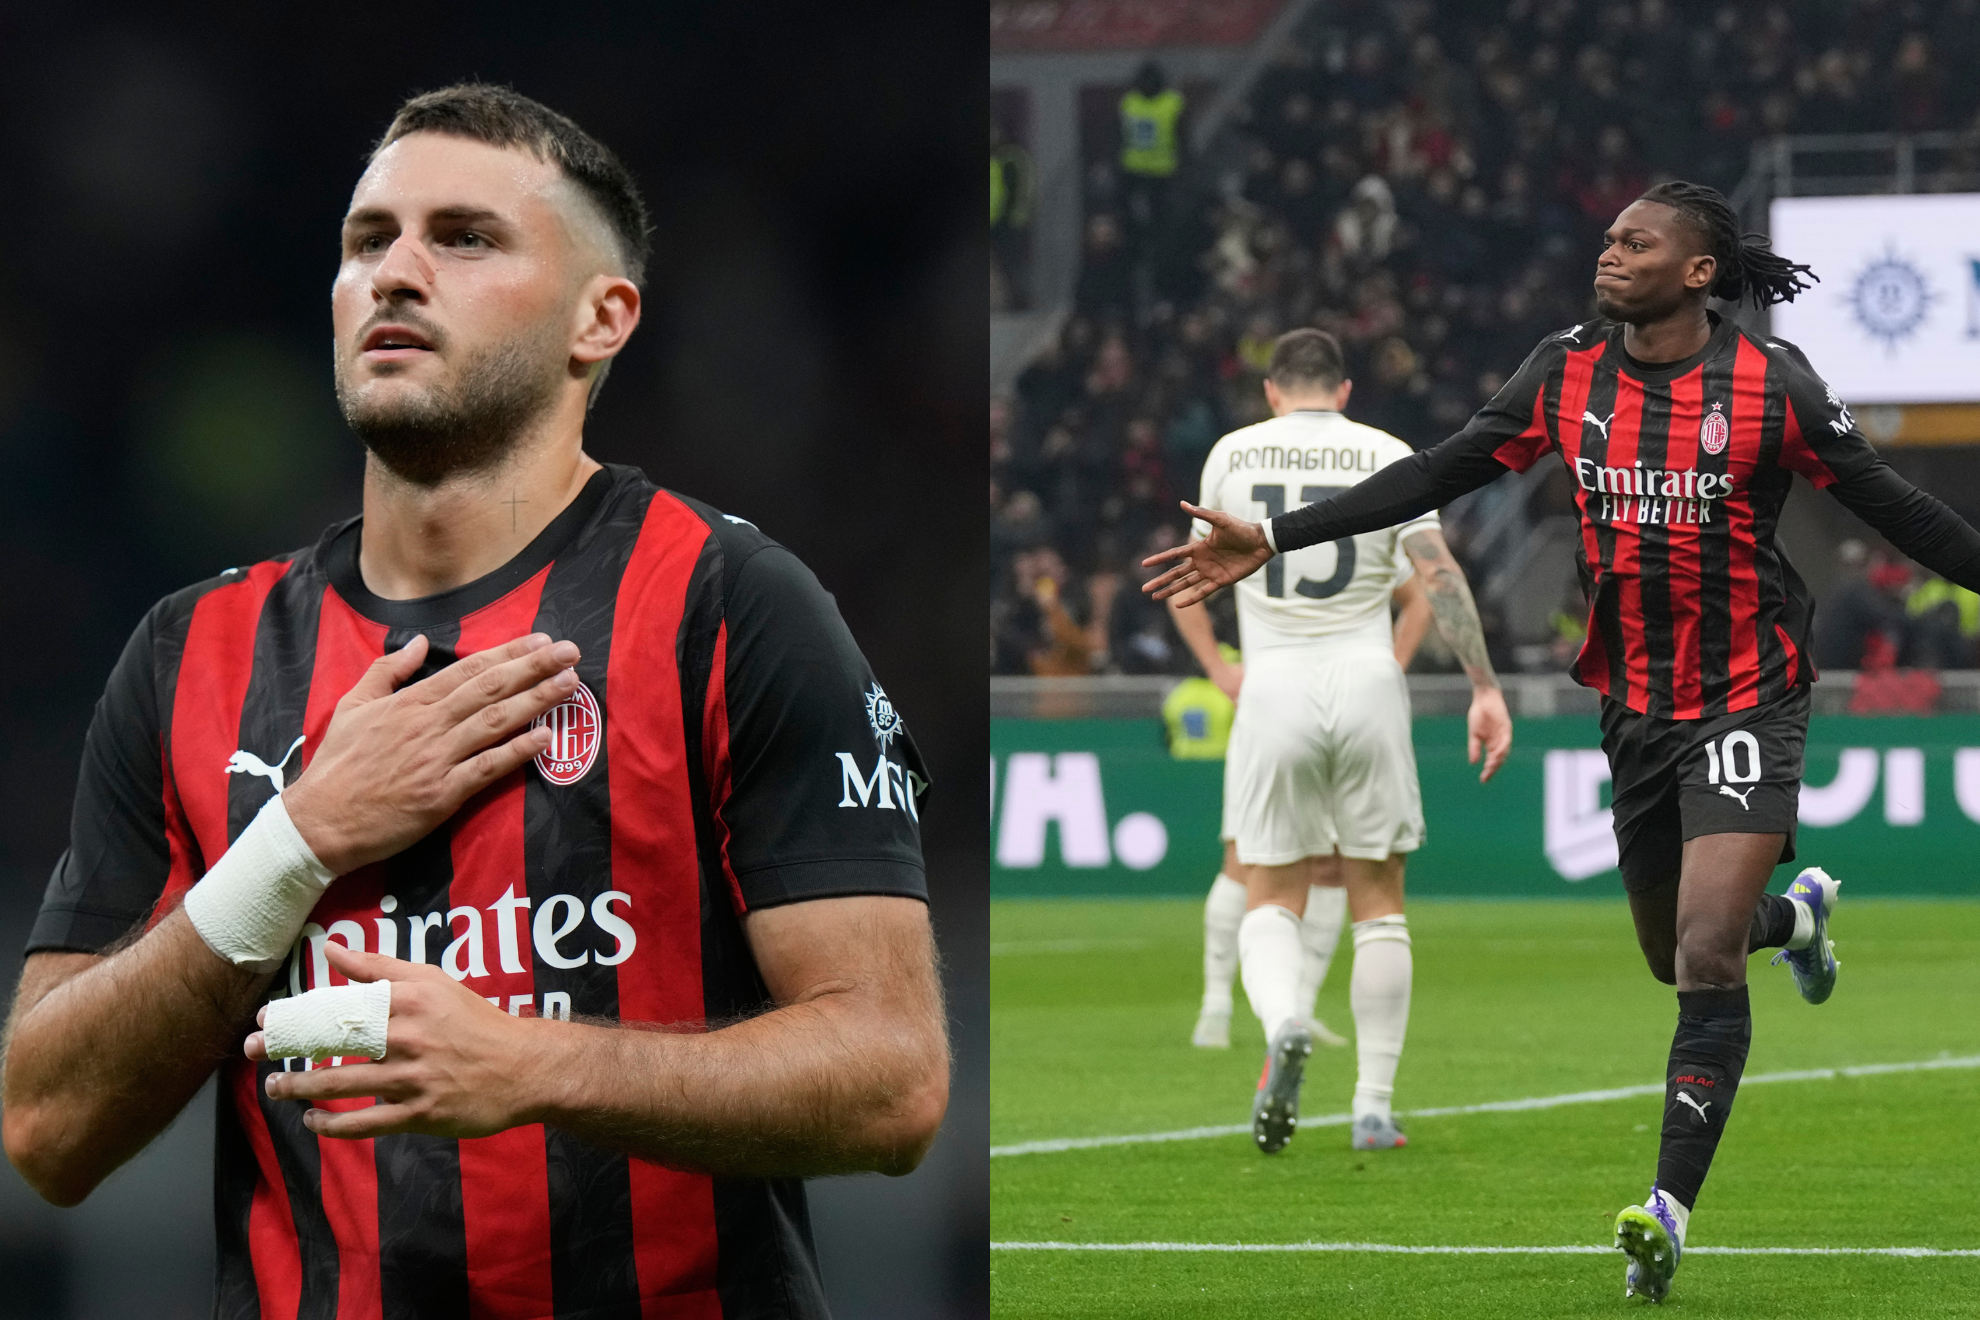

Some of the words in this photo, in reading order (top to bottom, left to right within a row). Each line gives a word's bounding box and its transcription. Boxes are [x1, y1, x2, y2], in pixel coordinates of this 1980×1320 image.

[1229, 446, 1376, 473] ROMAGNOLI
[1574, 456, 1735, 500] Emirates
[1601, 495, 1632, 520] FLY
[1637, 496, 1711, 524] BETTER
[1251, 484, 1357, 599] 15
[549, 760, 583, 773] 1899
[1704, 729, 1762, 785] 10
[268, 883, 637, 1002] mirates
